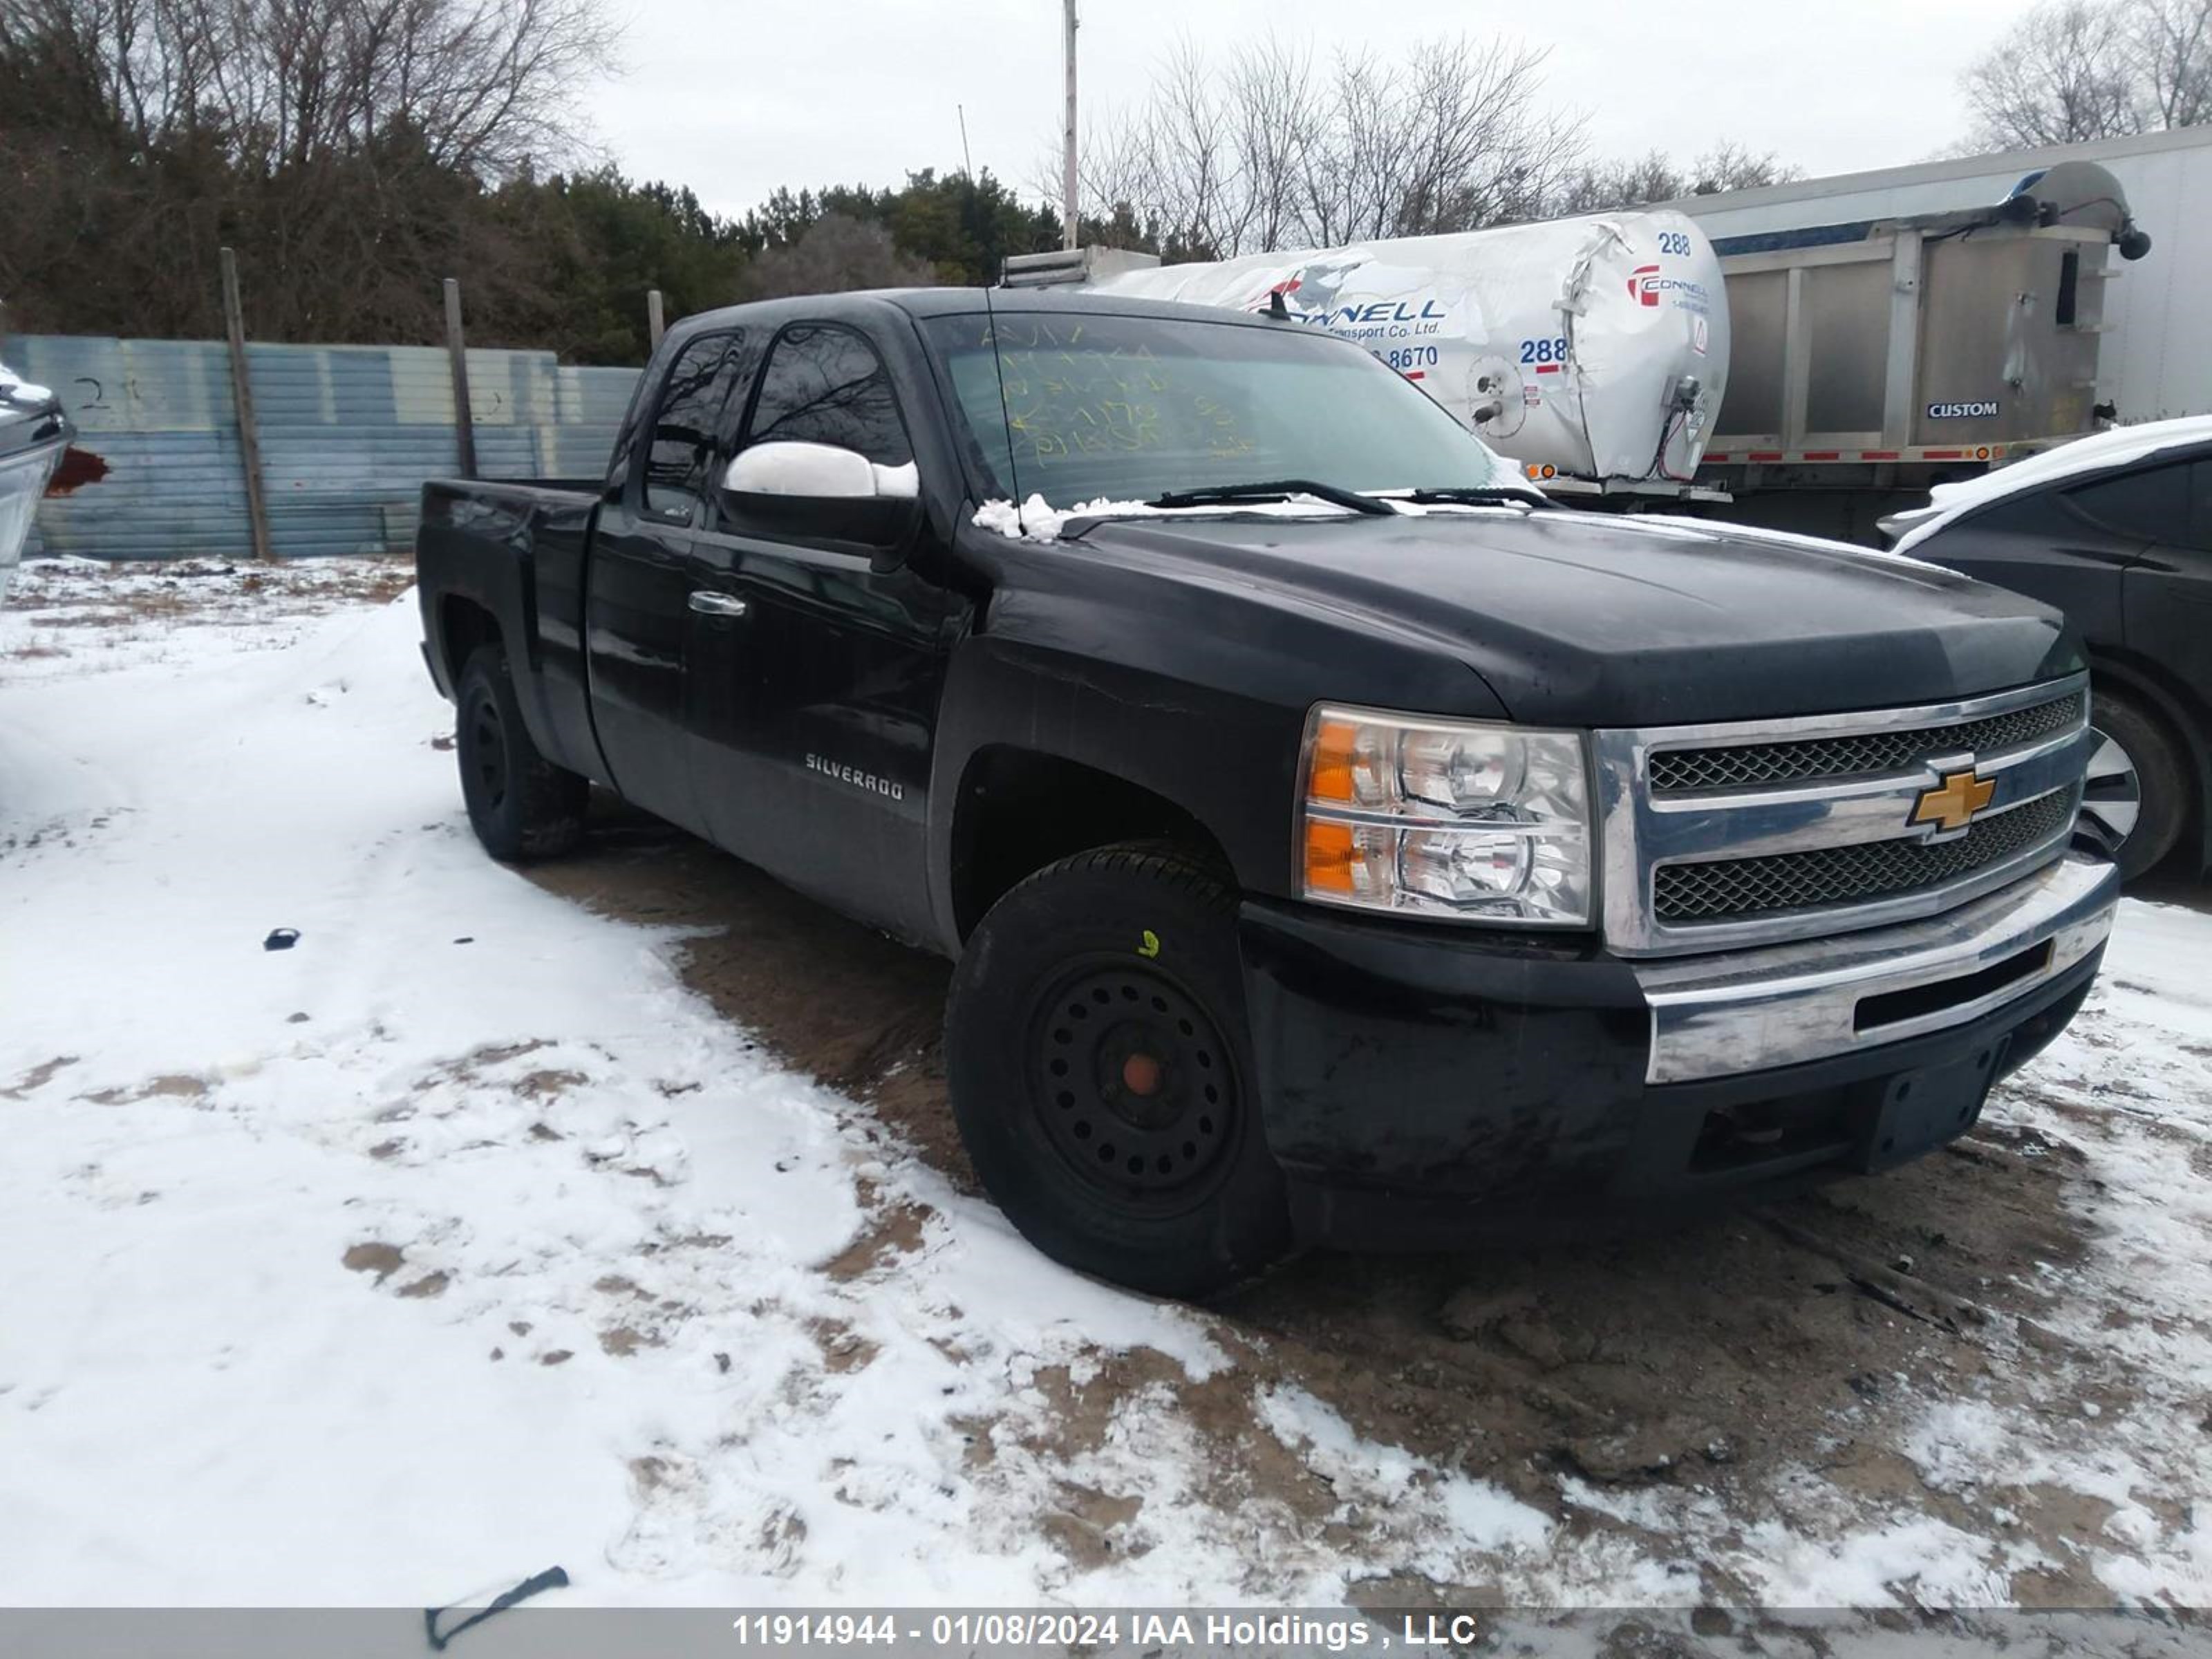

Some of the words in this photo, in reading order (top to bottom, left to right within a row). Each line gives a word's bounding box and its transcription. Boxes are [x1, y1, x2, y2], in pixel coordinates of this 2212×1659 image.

[1659, 232, 1691, 256] 288
[1414, 321, 1440, 335] Ltd.
[1521, 338, 1568, 364] 288
[1929, 402, 1998, 418] CUSTOM
[806, 753, 903, 800] SILVERADO
